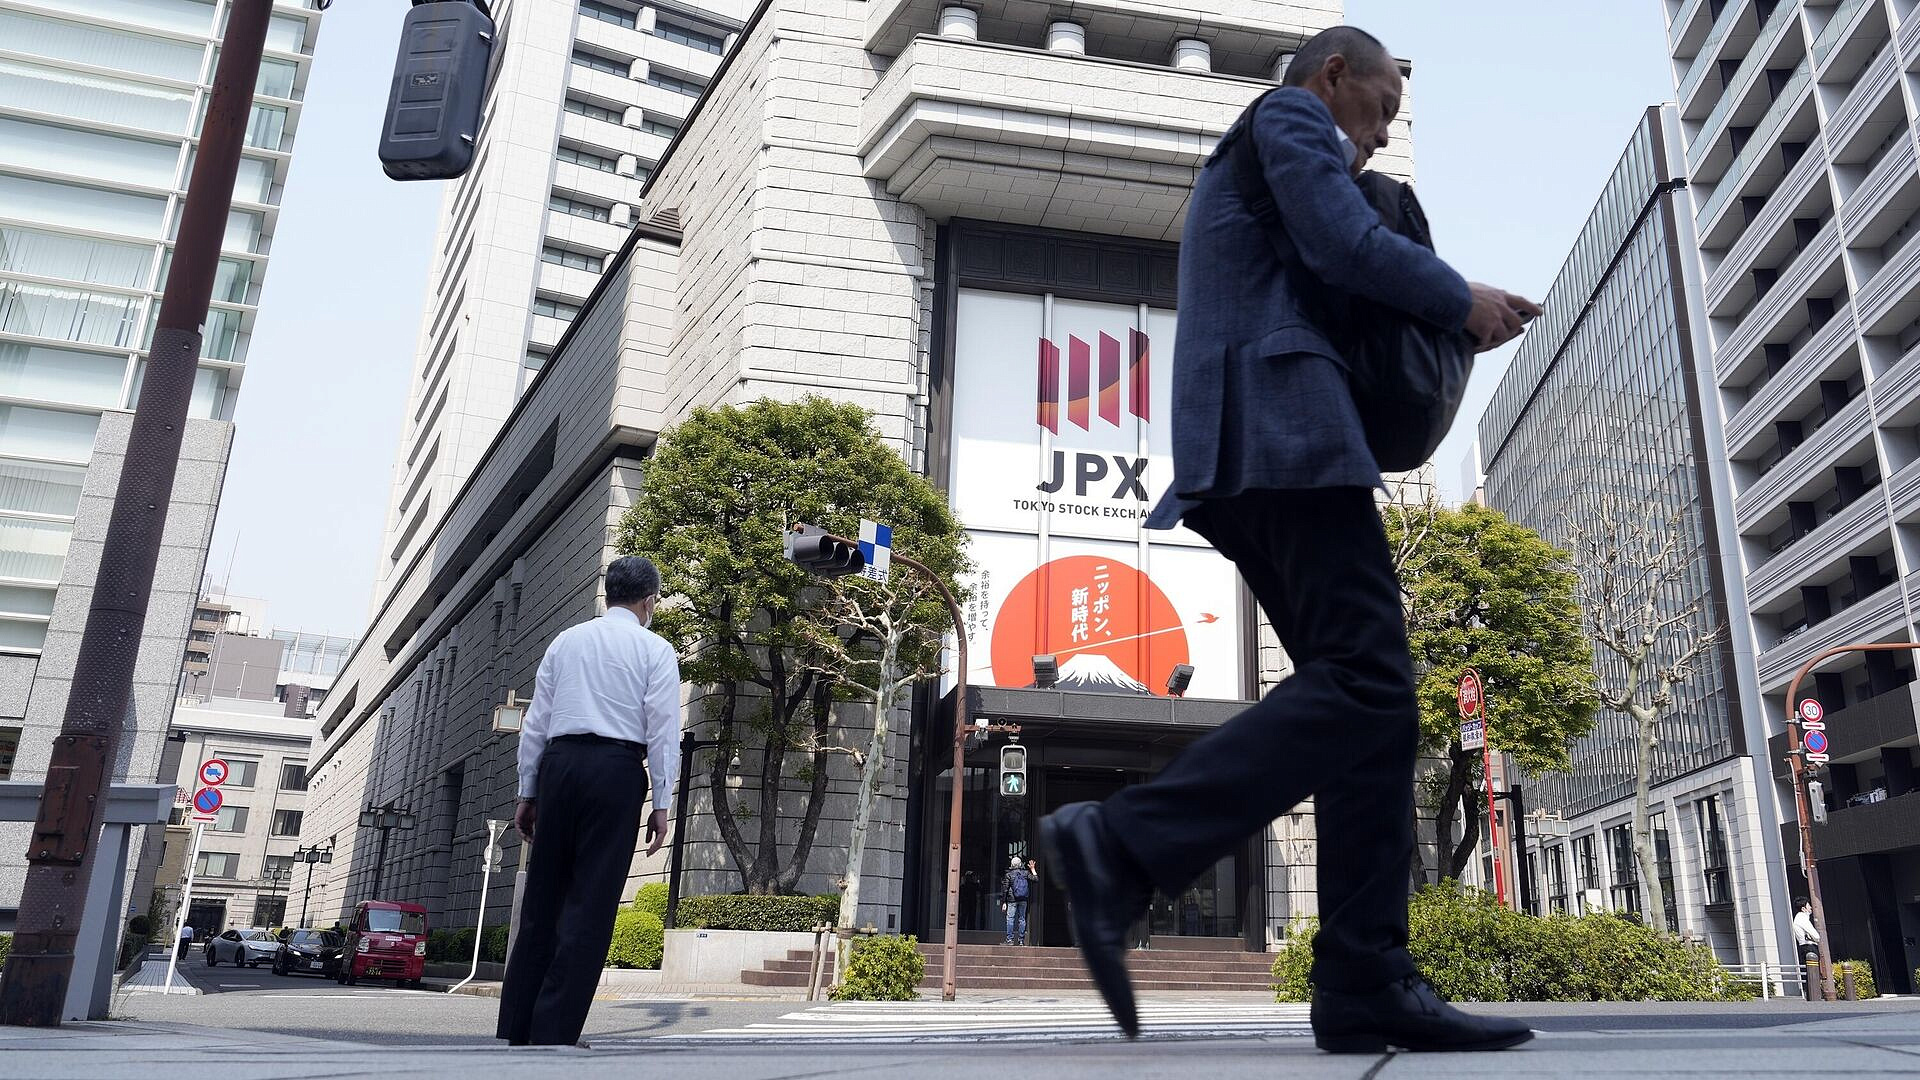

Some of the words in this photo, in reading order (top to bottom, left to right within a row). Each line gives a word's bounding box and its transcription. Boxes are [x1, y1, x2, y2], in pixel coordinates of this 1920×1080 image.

[1036, 450, 1149, 502] JPX
[1014, 499, 1055, 513] TOKYO
[1058, 503, 1100, 517] STOCK
[980, 569, 990, 631] 余裕を持って、
[1071, 586, 1089, 643] 新時代
[1093, 564, 1111, 636] ニッポン、
[1805, 705, 1818, 716] 30
